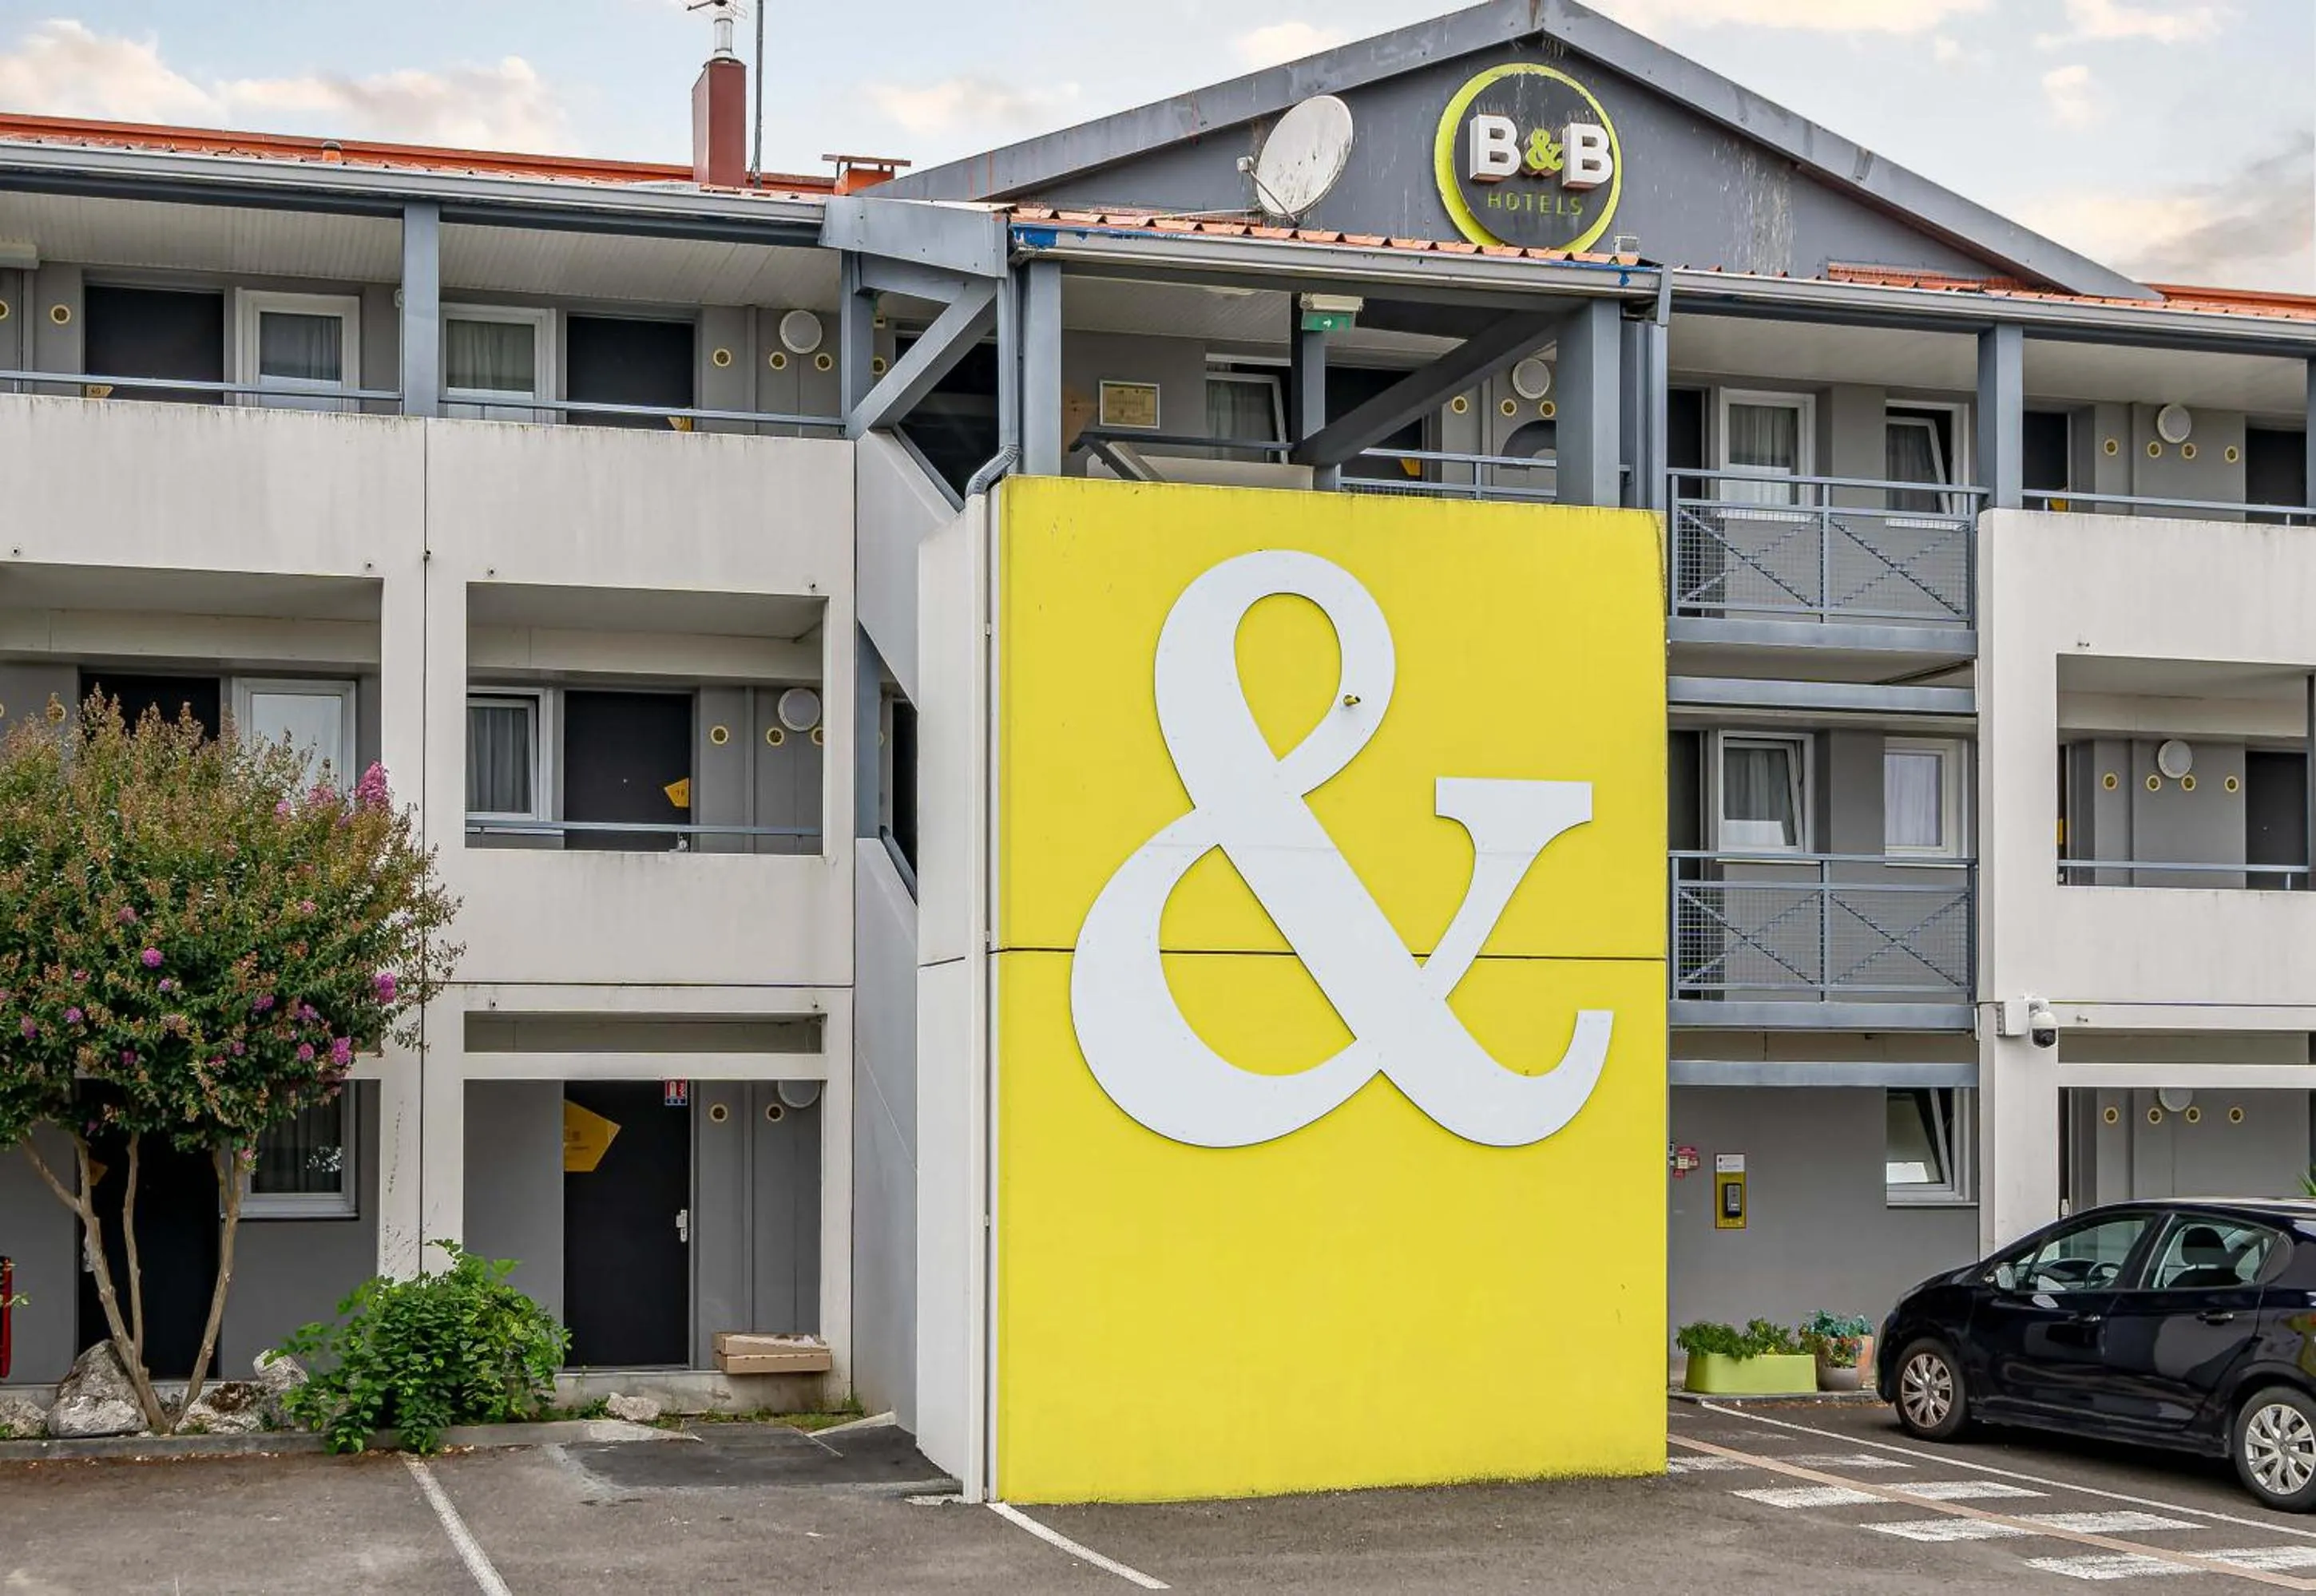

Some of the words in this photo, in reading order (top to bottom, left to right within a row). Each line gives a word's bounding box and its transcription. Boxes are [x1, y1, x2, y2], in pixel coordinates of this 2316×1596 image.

[1469, 113, 1614, 187] B&B
[1488, 192, 1583, 216] HOTELS
[1070, 549, 1613, 1148] &
